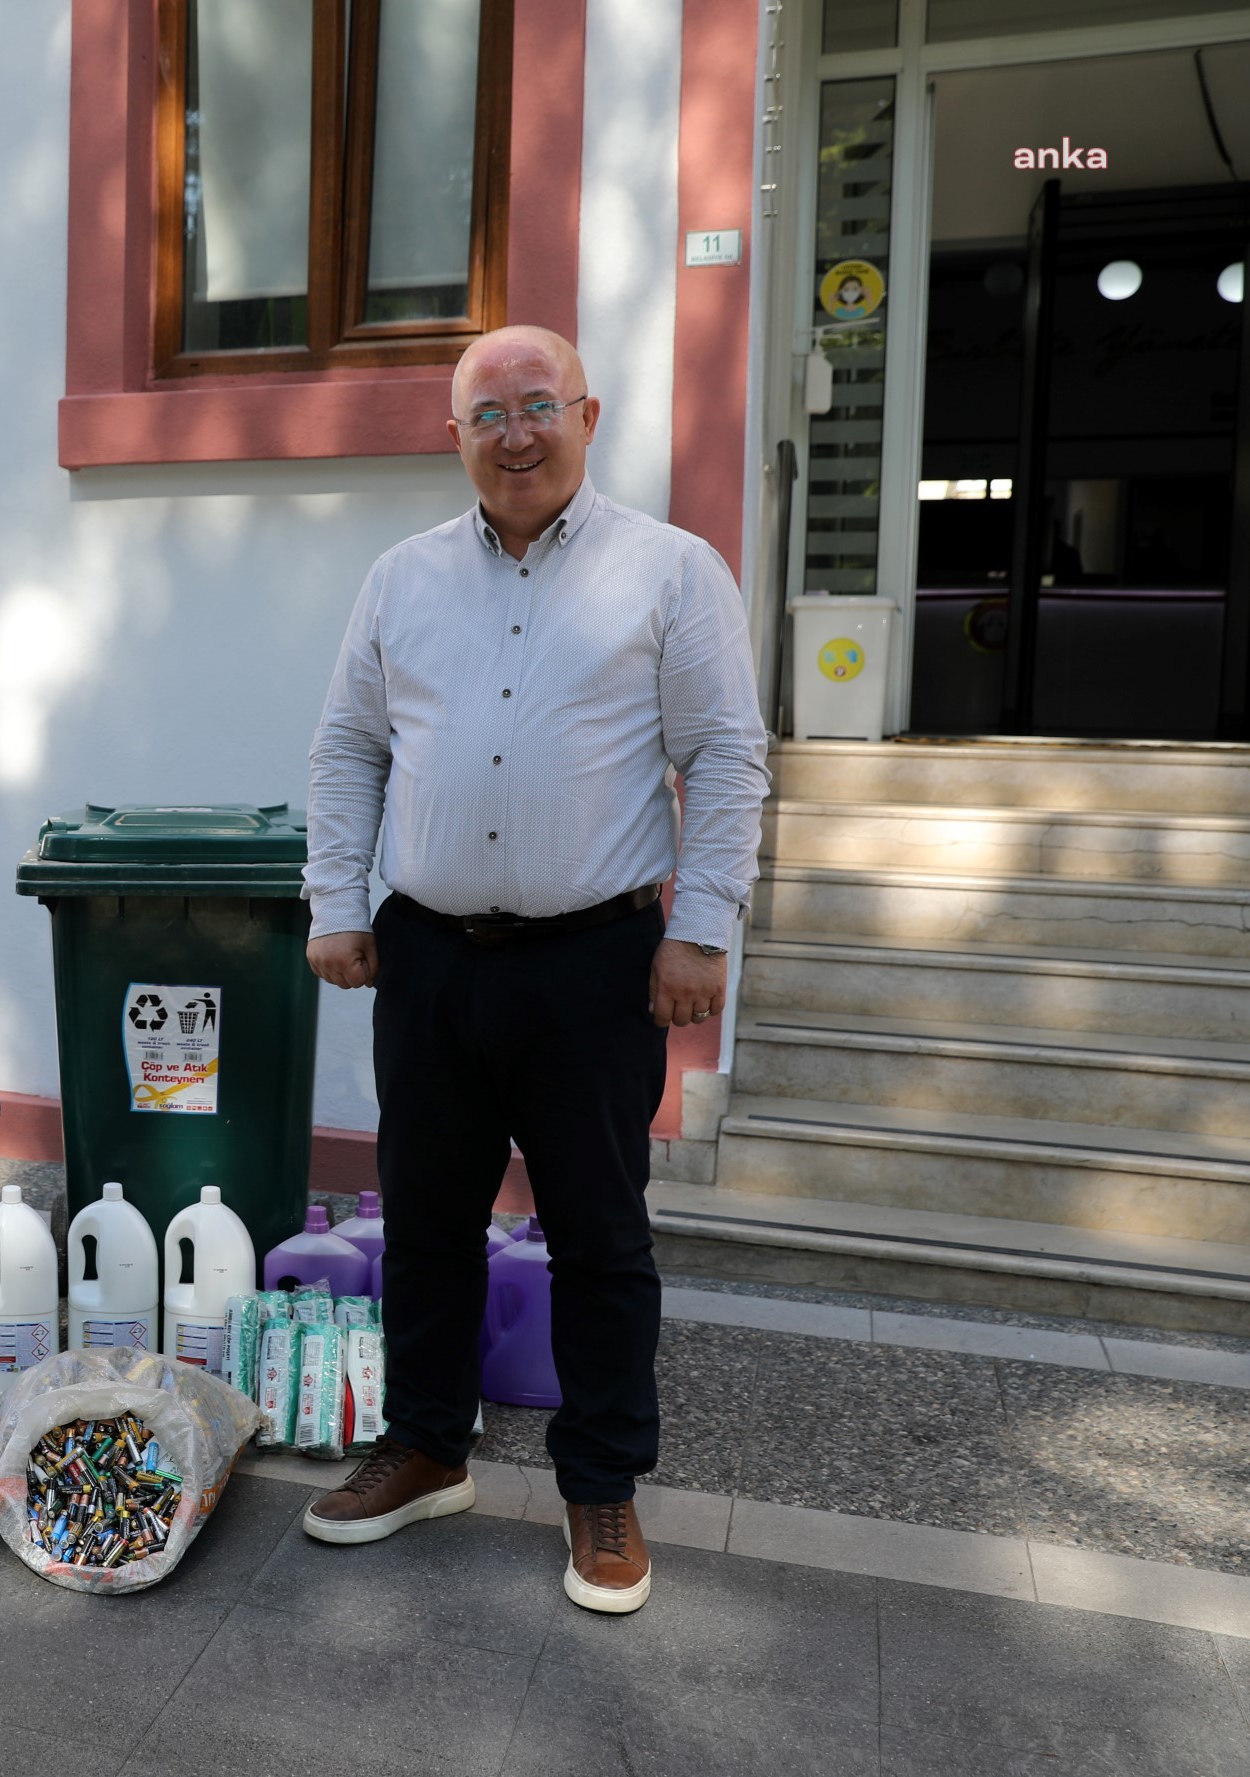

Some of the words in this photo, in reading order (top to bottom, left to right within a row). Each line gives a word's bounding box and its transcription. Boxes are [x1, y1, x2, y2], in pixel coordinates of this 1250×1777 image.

[702, 234, 720, 253] 11
[141, 1061, 162, 1073] Çöp
[183, 1063, 208, 1072] Atık
